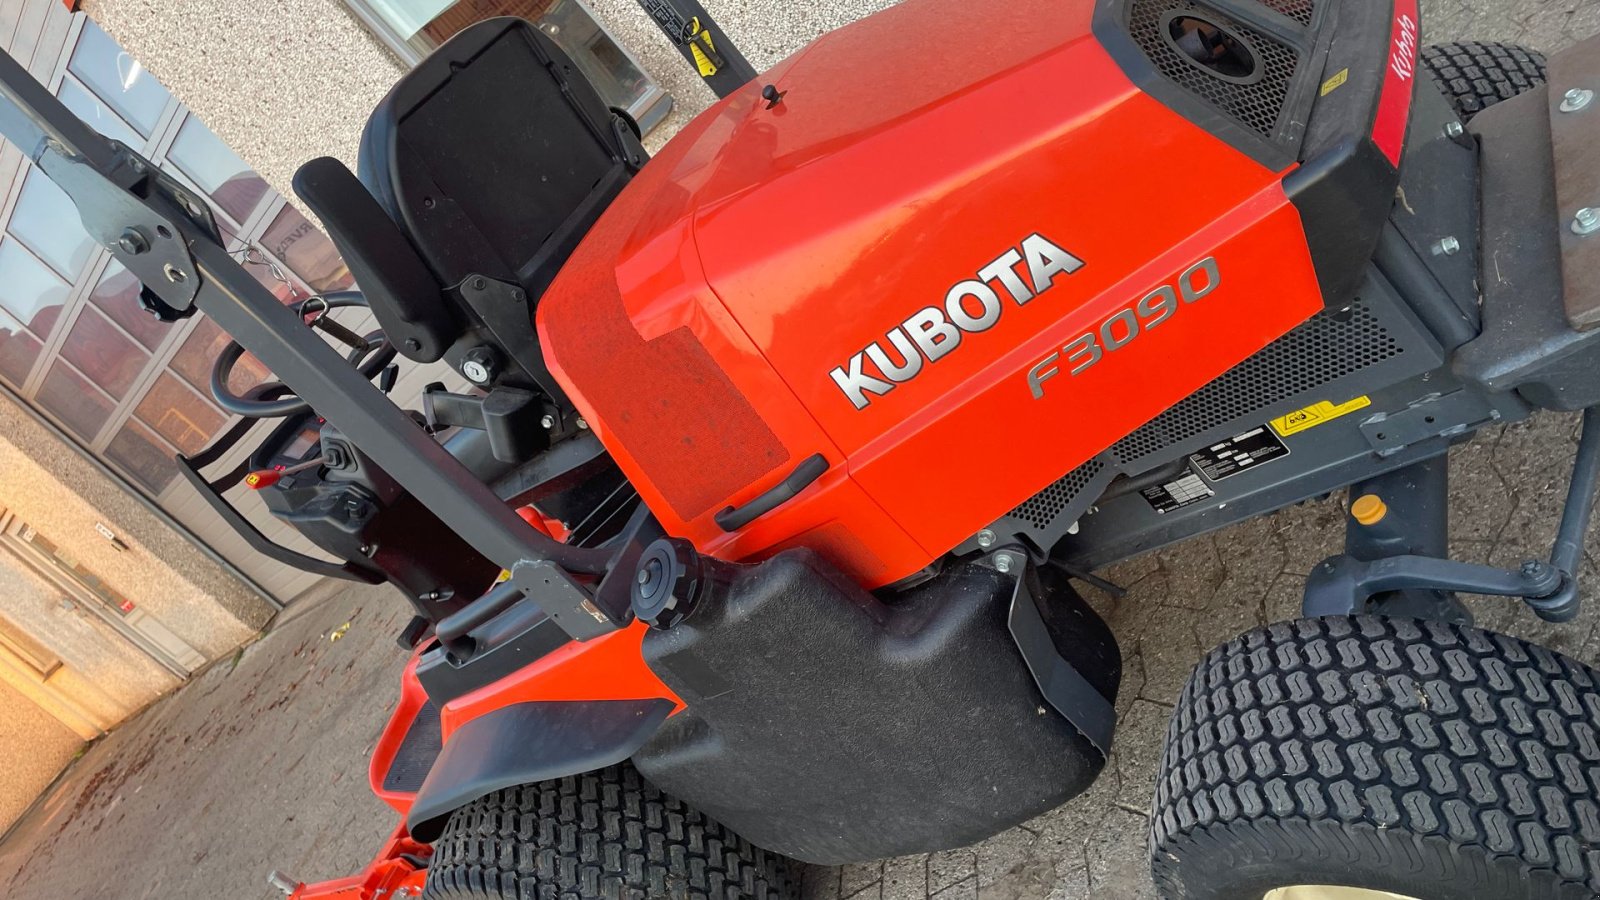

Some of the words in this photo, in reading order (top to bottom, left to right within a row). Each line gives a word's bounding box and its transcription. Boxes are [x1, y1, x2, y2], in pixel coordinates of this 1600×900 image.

[1391, 14, 1415, 81] Kubota
[828, 232, 1086, 411] KUBOTA
[1026, 256, 1221, 400] F3090
